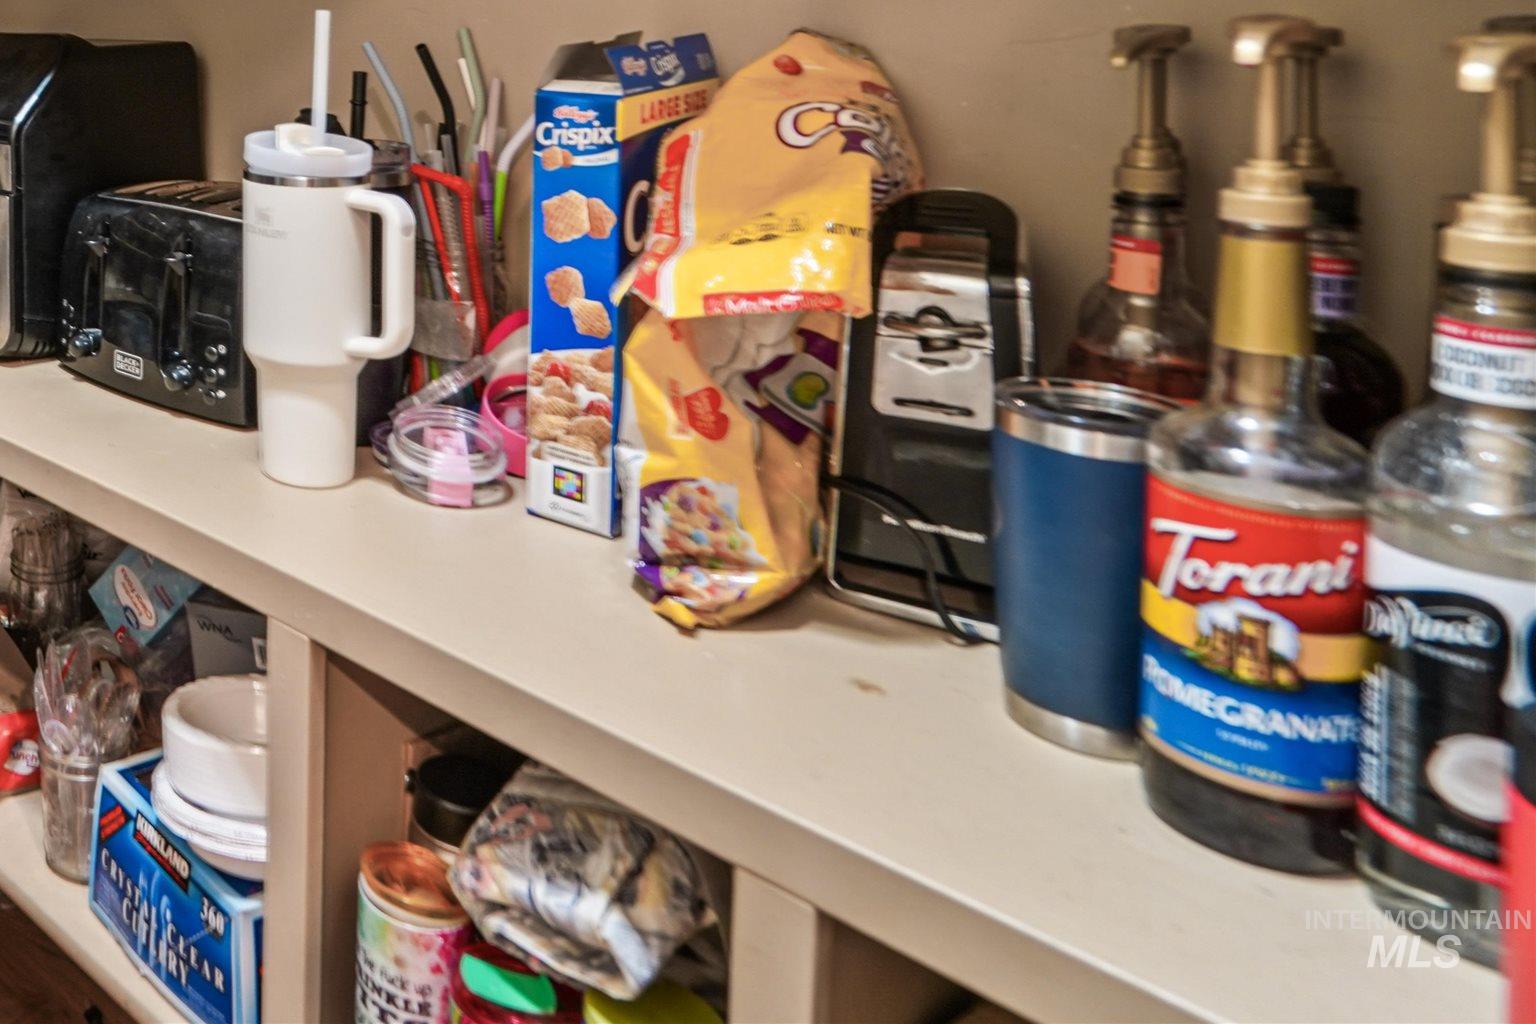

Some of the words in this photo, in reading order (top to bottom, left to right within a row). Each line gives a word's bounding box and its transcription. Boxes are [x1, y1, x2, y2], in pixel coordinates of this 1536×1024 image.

[536, 120, 615, 151] Crispix
[640, 95, 681, 125] LARGE
[1150, 517, 1360, 599] Torani
[136, 813, 190, 880] KIRKLAND
[200, 895, 225, 937] 360
[167, 921, 225, 994] CLEAR
